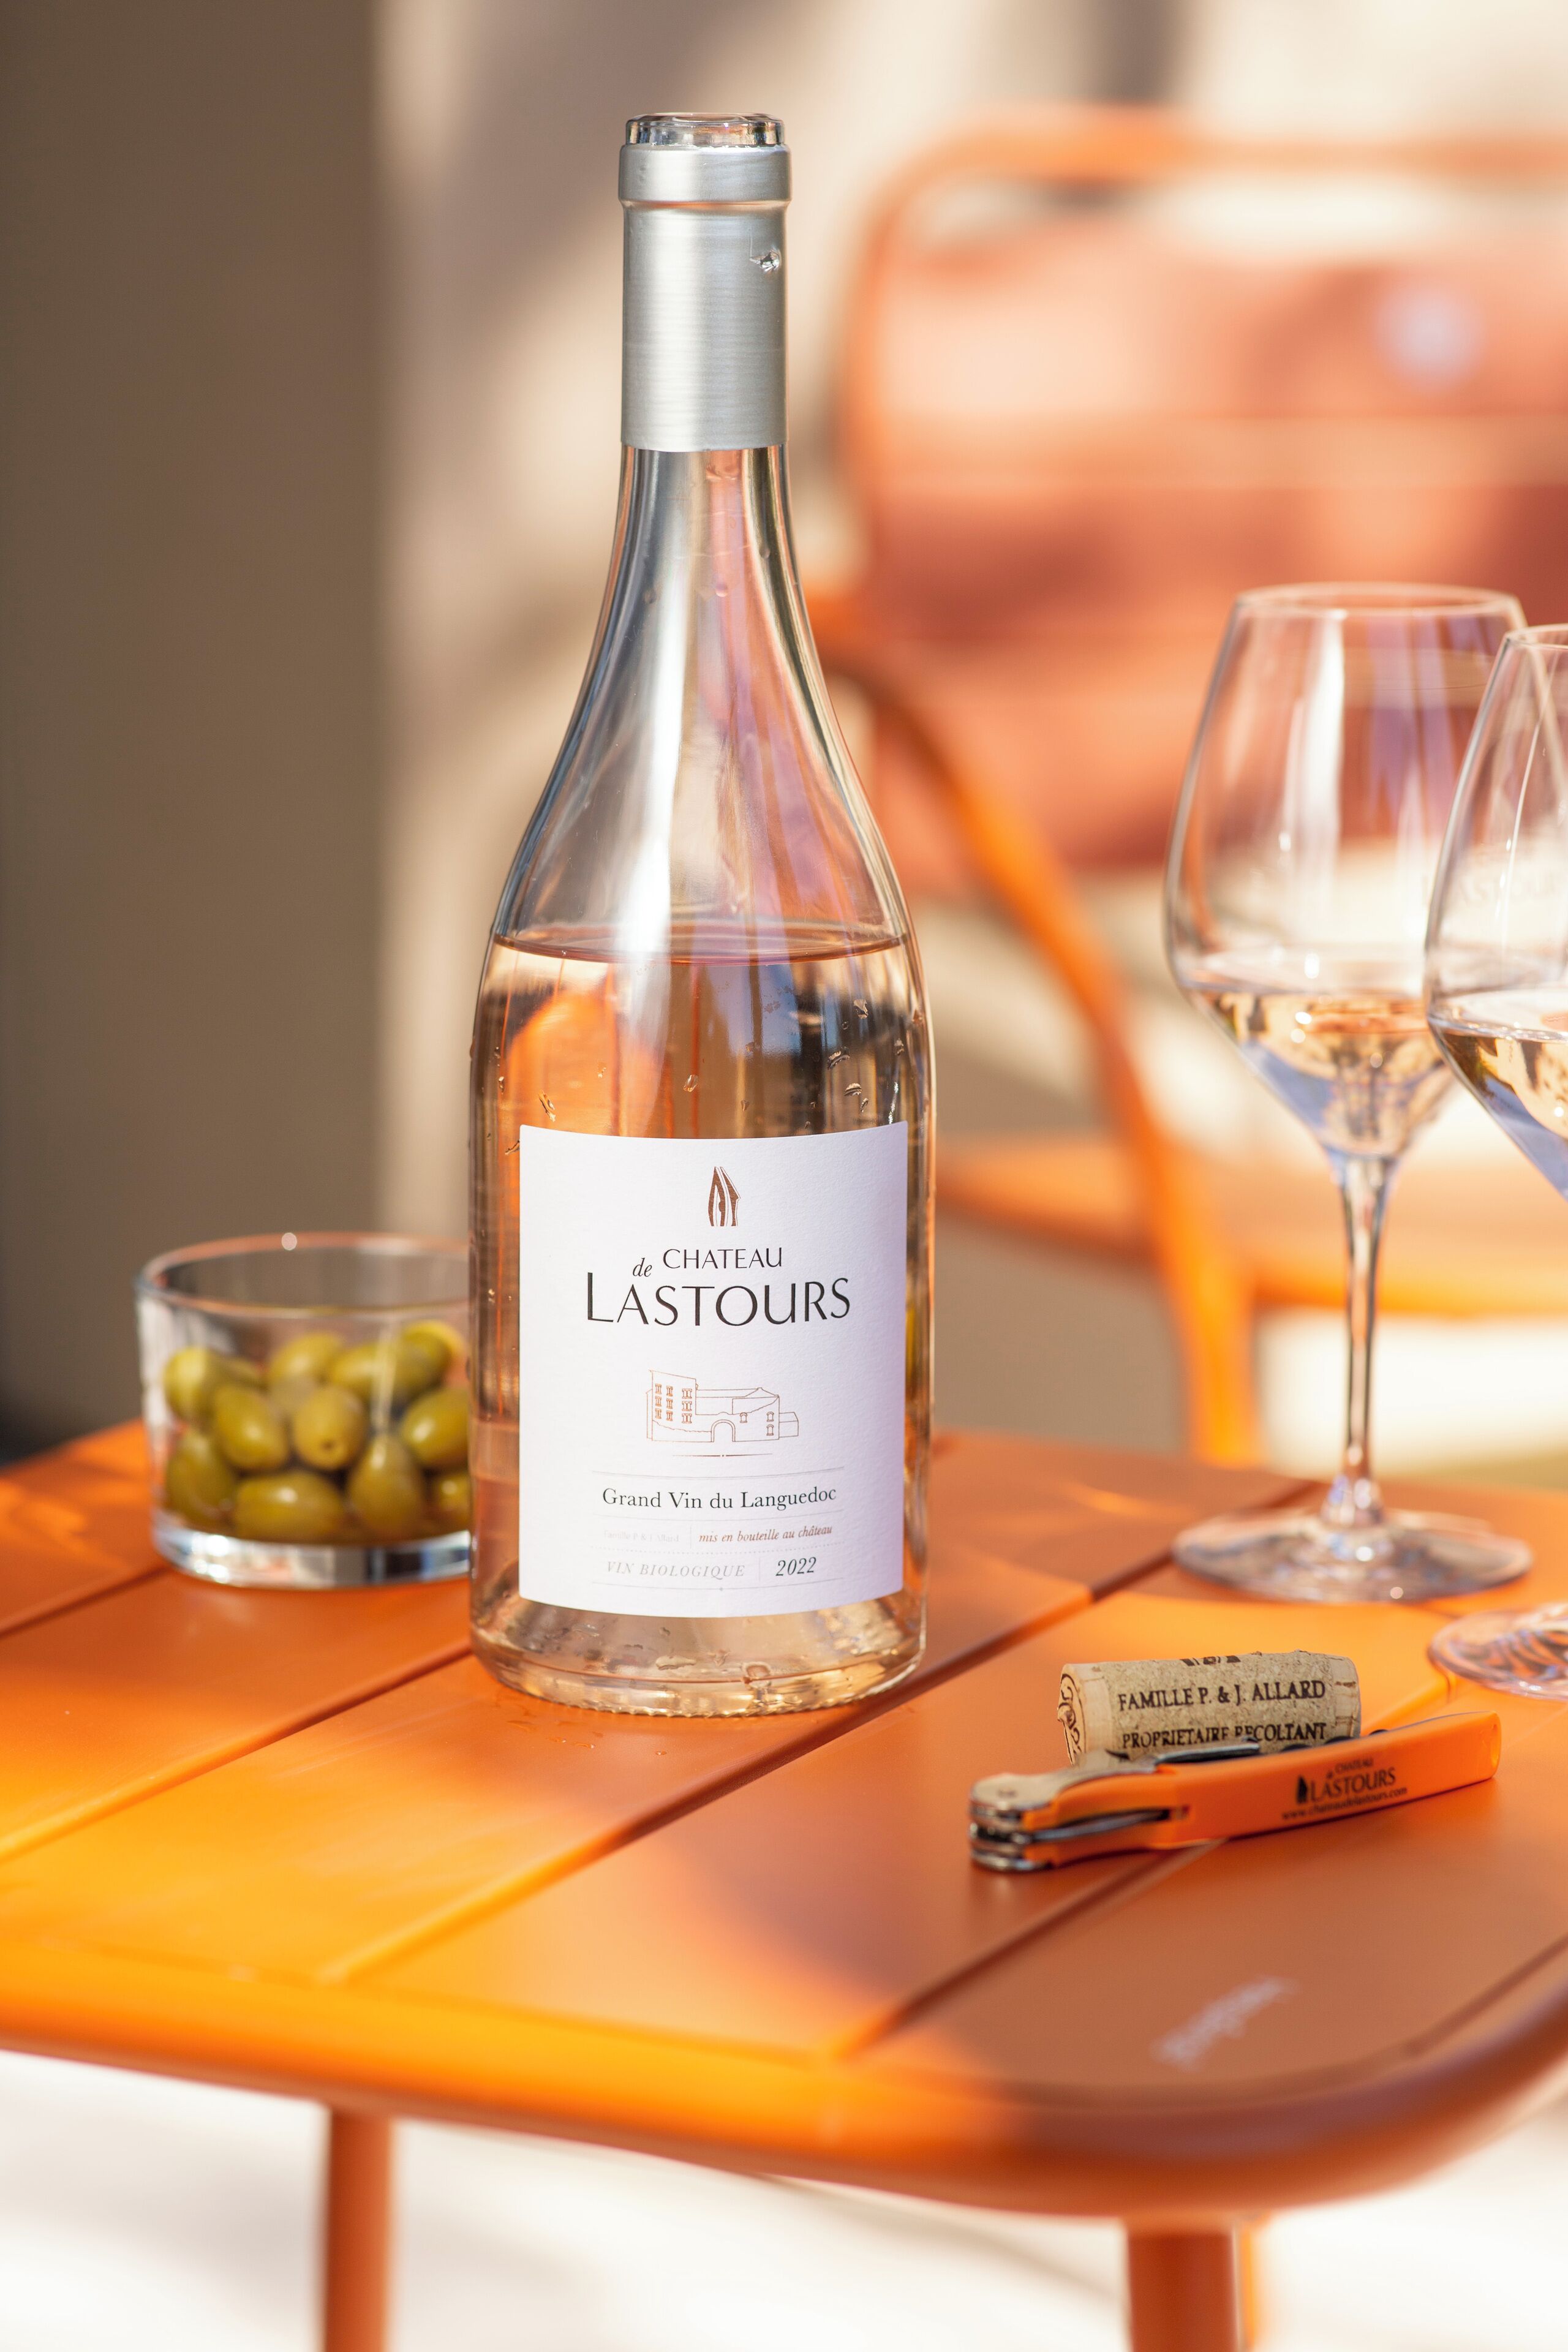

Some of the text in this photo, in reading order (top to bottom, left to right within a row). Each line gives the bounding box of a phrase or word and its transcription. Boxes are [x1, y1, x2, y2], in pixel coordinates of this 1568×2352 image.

[632, 1246, 783, 1278] de CHATEAU
[587, 1272, 851, 1327] LASTOURS
[602, 1486, 837, 1511] Grand Vin du Languedoc
[698, 1525, 833, 1543] mis en bouteille au château
[606, 1561, 746, 1580] VIN BIOLOGIQUE
[775, 1556, 817, 1577] 2022
[1117, 1679, 1326, 1711] FAMILLE P. & J. ALLARD
[1310, 1766, 1396, 1803] LASTOURS
